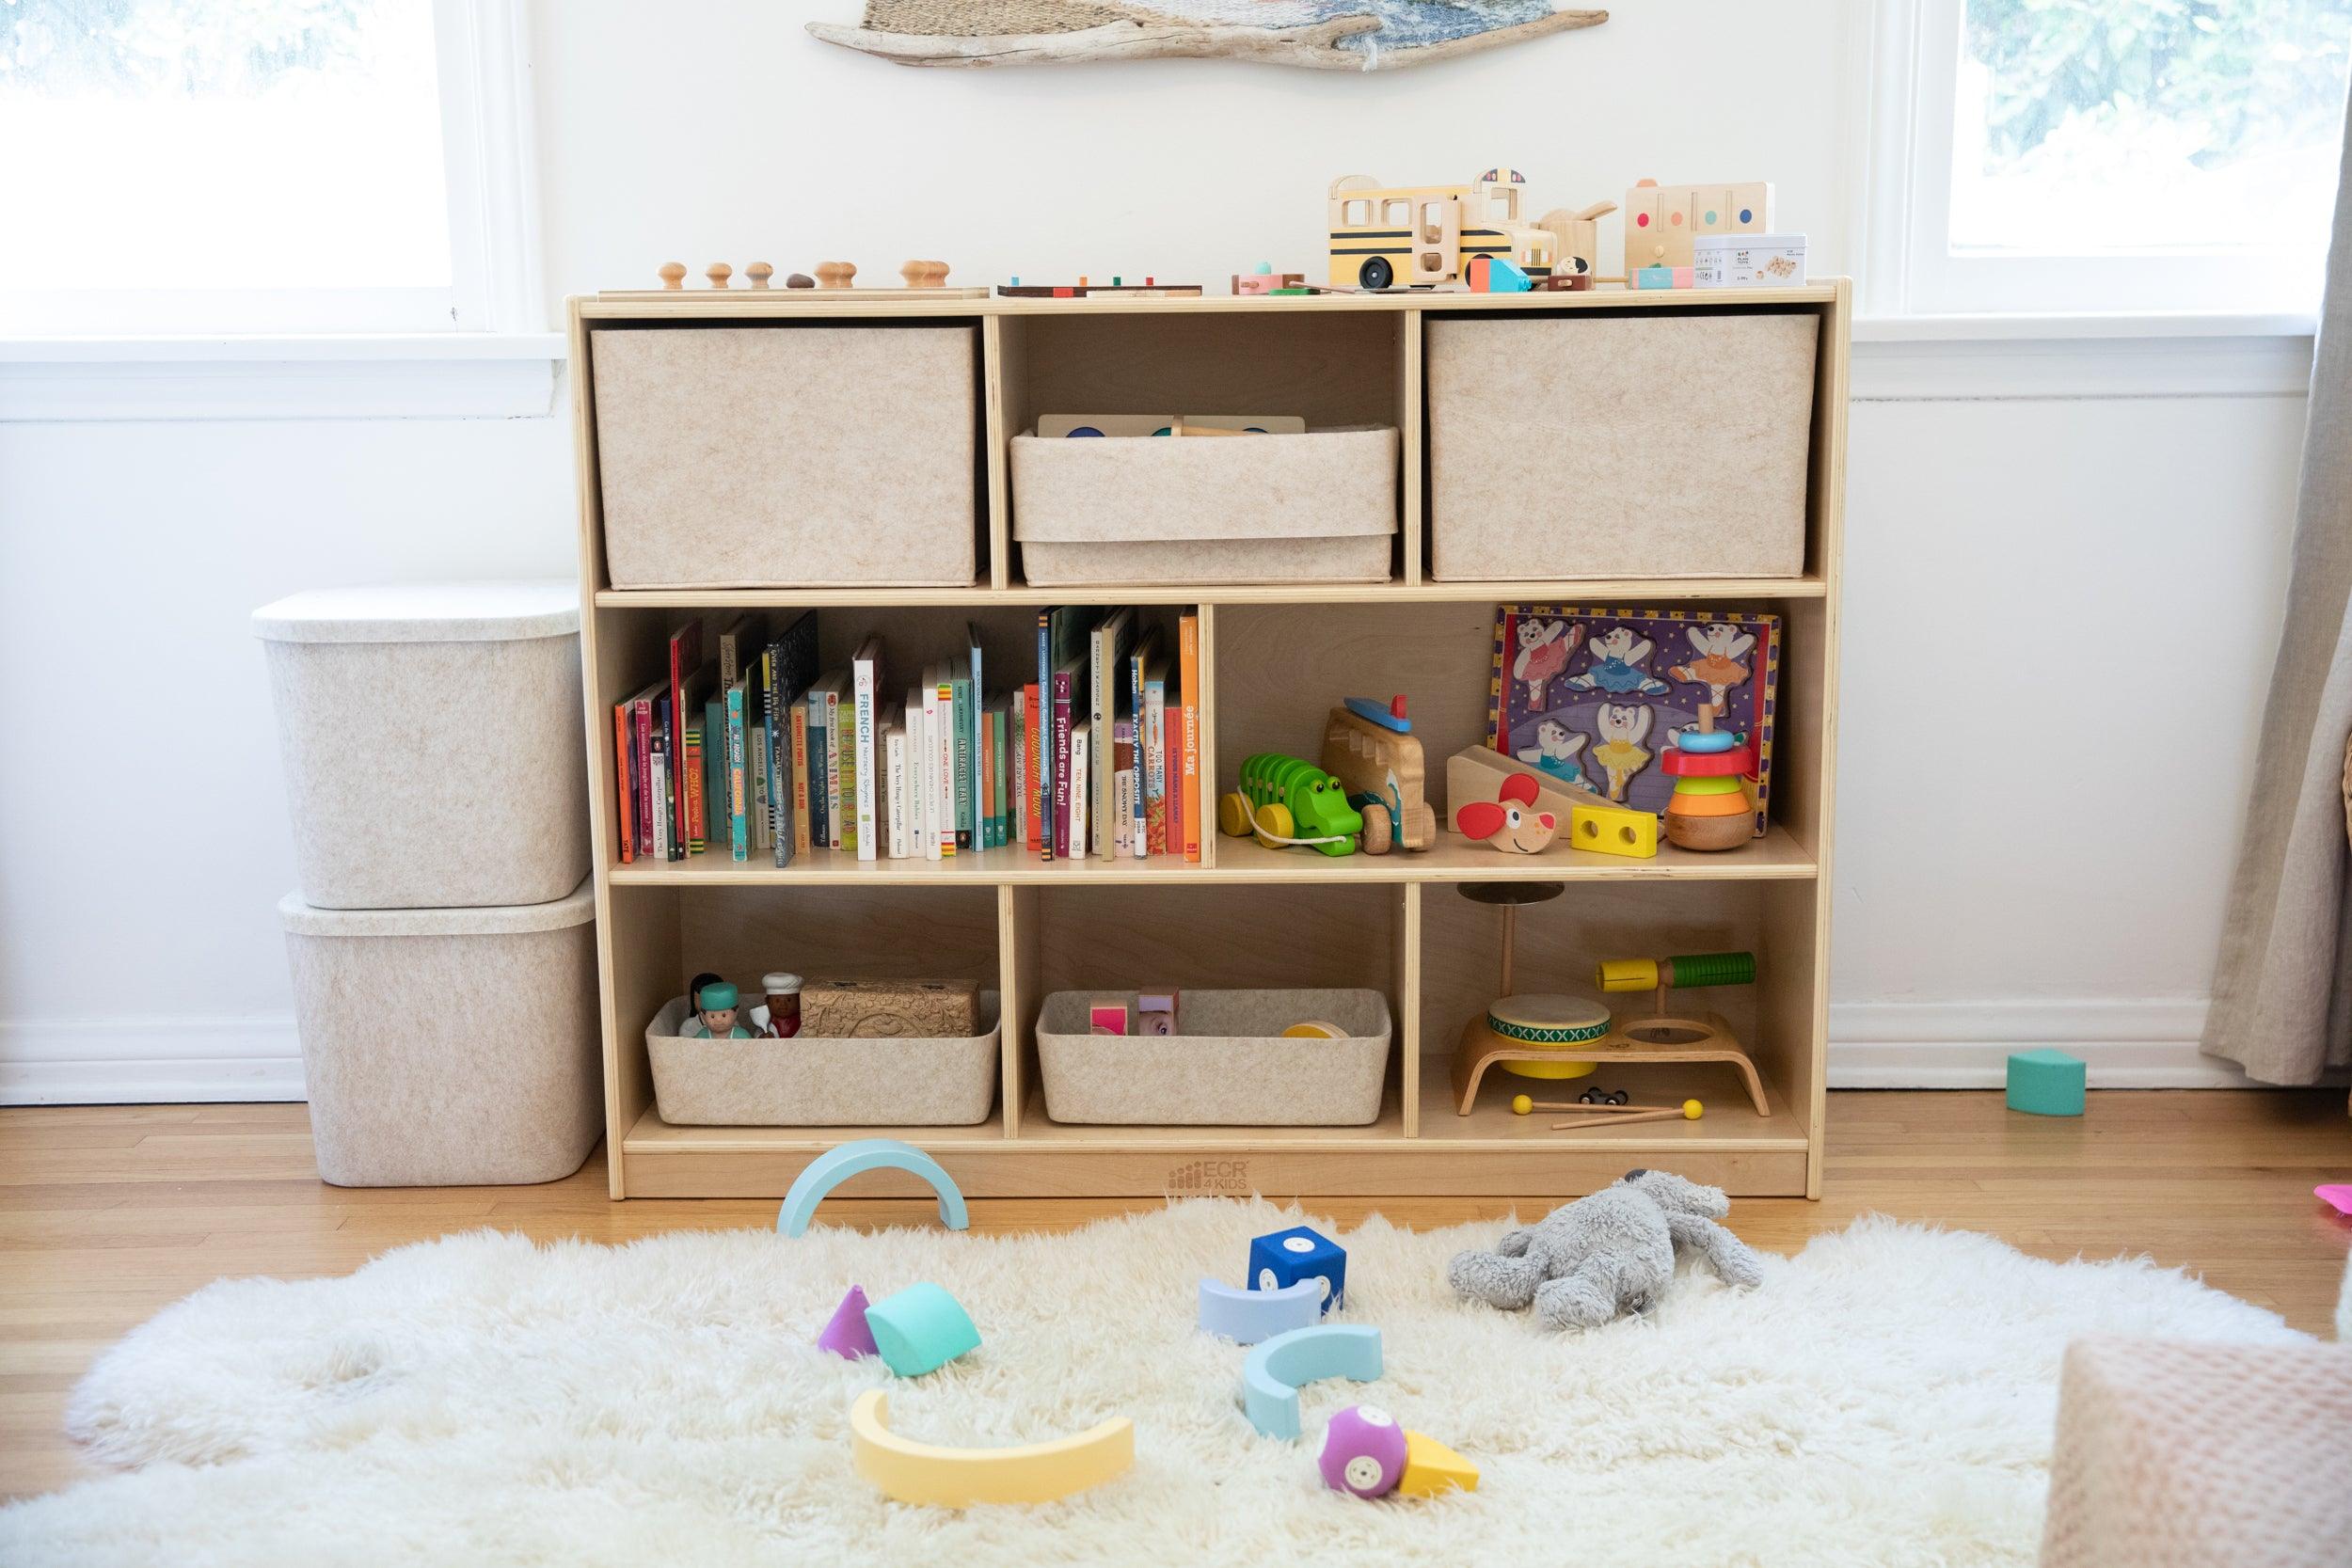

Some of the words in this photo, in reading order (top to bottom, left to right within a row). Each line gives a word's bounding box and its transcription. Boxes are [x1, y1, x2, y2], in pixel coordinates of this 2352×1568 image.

[860, 693, 869, 743] FRENCH
[1184, 705, 1197, 754] journée
[842, 729, 854, 766] BECAUSE
[1057, 717, 1069, 760] Friends
[861, 746, 870, 776] Nursery
[958, 739, 967, 783] ANTIRACIST
[1015, 752, 1022, 764] MY
[1031, 727, 1041, 783] GOODNIGHT
[1185, 755, 1195, 776] Ma
[690, 768, 699, 798] WHO?
[829, 752, 838, 810] ANIMALS
[1058, 762, 1067, 779] are
[734, 768, 743, 815] CALIFORNIA
[842, 785, 855, 811] YOUR
[860, 779, 870, 808] Rhymes
[959, 787, 967, 806] BABY
[1033, 788, 1041, 817] MOON
[1057, 781, 1068, 806] Fun!
[818, 805, 825, 814] On
[894, 805, 902, 831] Caterpillar
[1203, 1161, 1247, 1178] ECR
